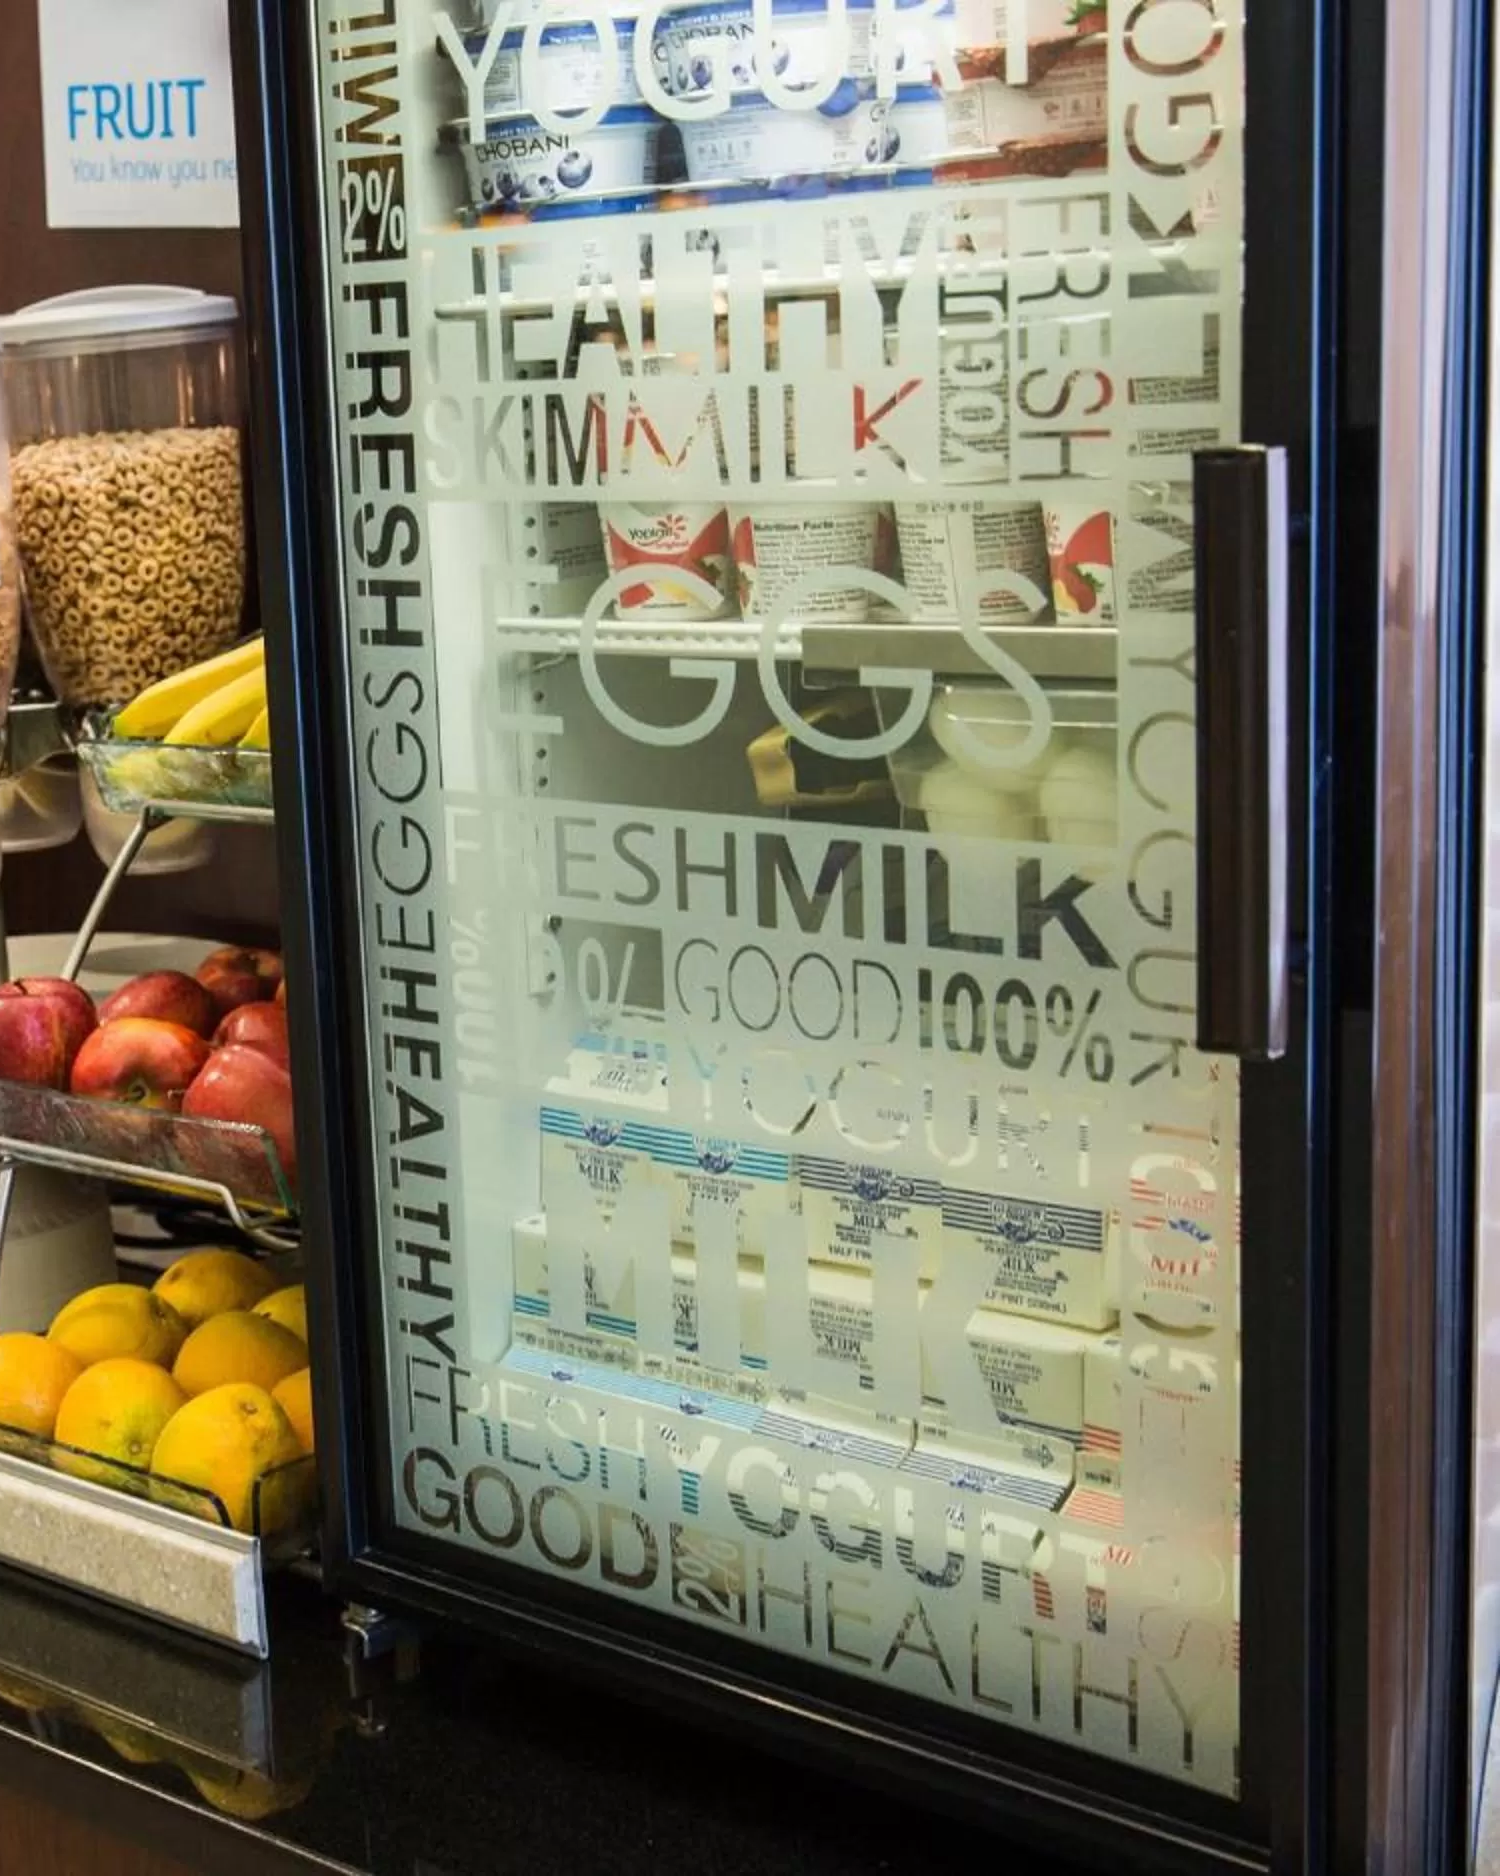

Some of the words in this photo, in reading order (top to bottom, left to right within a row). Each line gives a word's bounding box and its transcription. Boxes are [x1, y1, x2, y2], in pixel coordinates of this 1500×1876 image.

[67, 79, 206, 141] FRUIT
[329, 0, 402, 145] MIL
[432, 0, 1032, 145] YOGURT
[71, 158, 106, 184] You
[110, 154, 163, 181] know
[167, 159, 208, 190] you
[212, 158, 237, 181] ne
[341, 166, 406, 256] 2%
[475, 133, 570, 164] CHOBANI
[422, 206, 932, 386] HEALTHY
[343, 279, 426, 648] FRESH
[364, 670, 434, 953] EGGS
[755, 830, 1120, 970] MILK
[674, 936, 904, 1043] GOOD
[917, 967, 1115, 1083] 100%
[376, 970, 458, 1366] HEALTHY
[579, 1162, 621, 1187] MILK
[403, 1446, 659, 1590] GOOD
[405, 1353, 649, 1500] FRESH
[657, 1423, 1140, 1635] YOGURT
[757, 1548, 1222, 1772] HEALTHY
